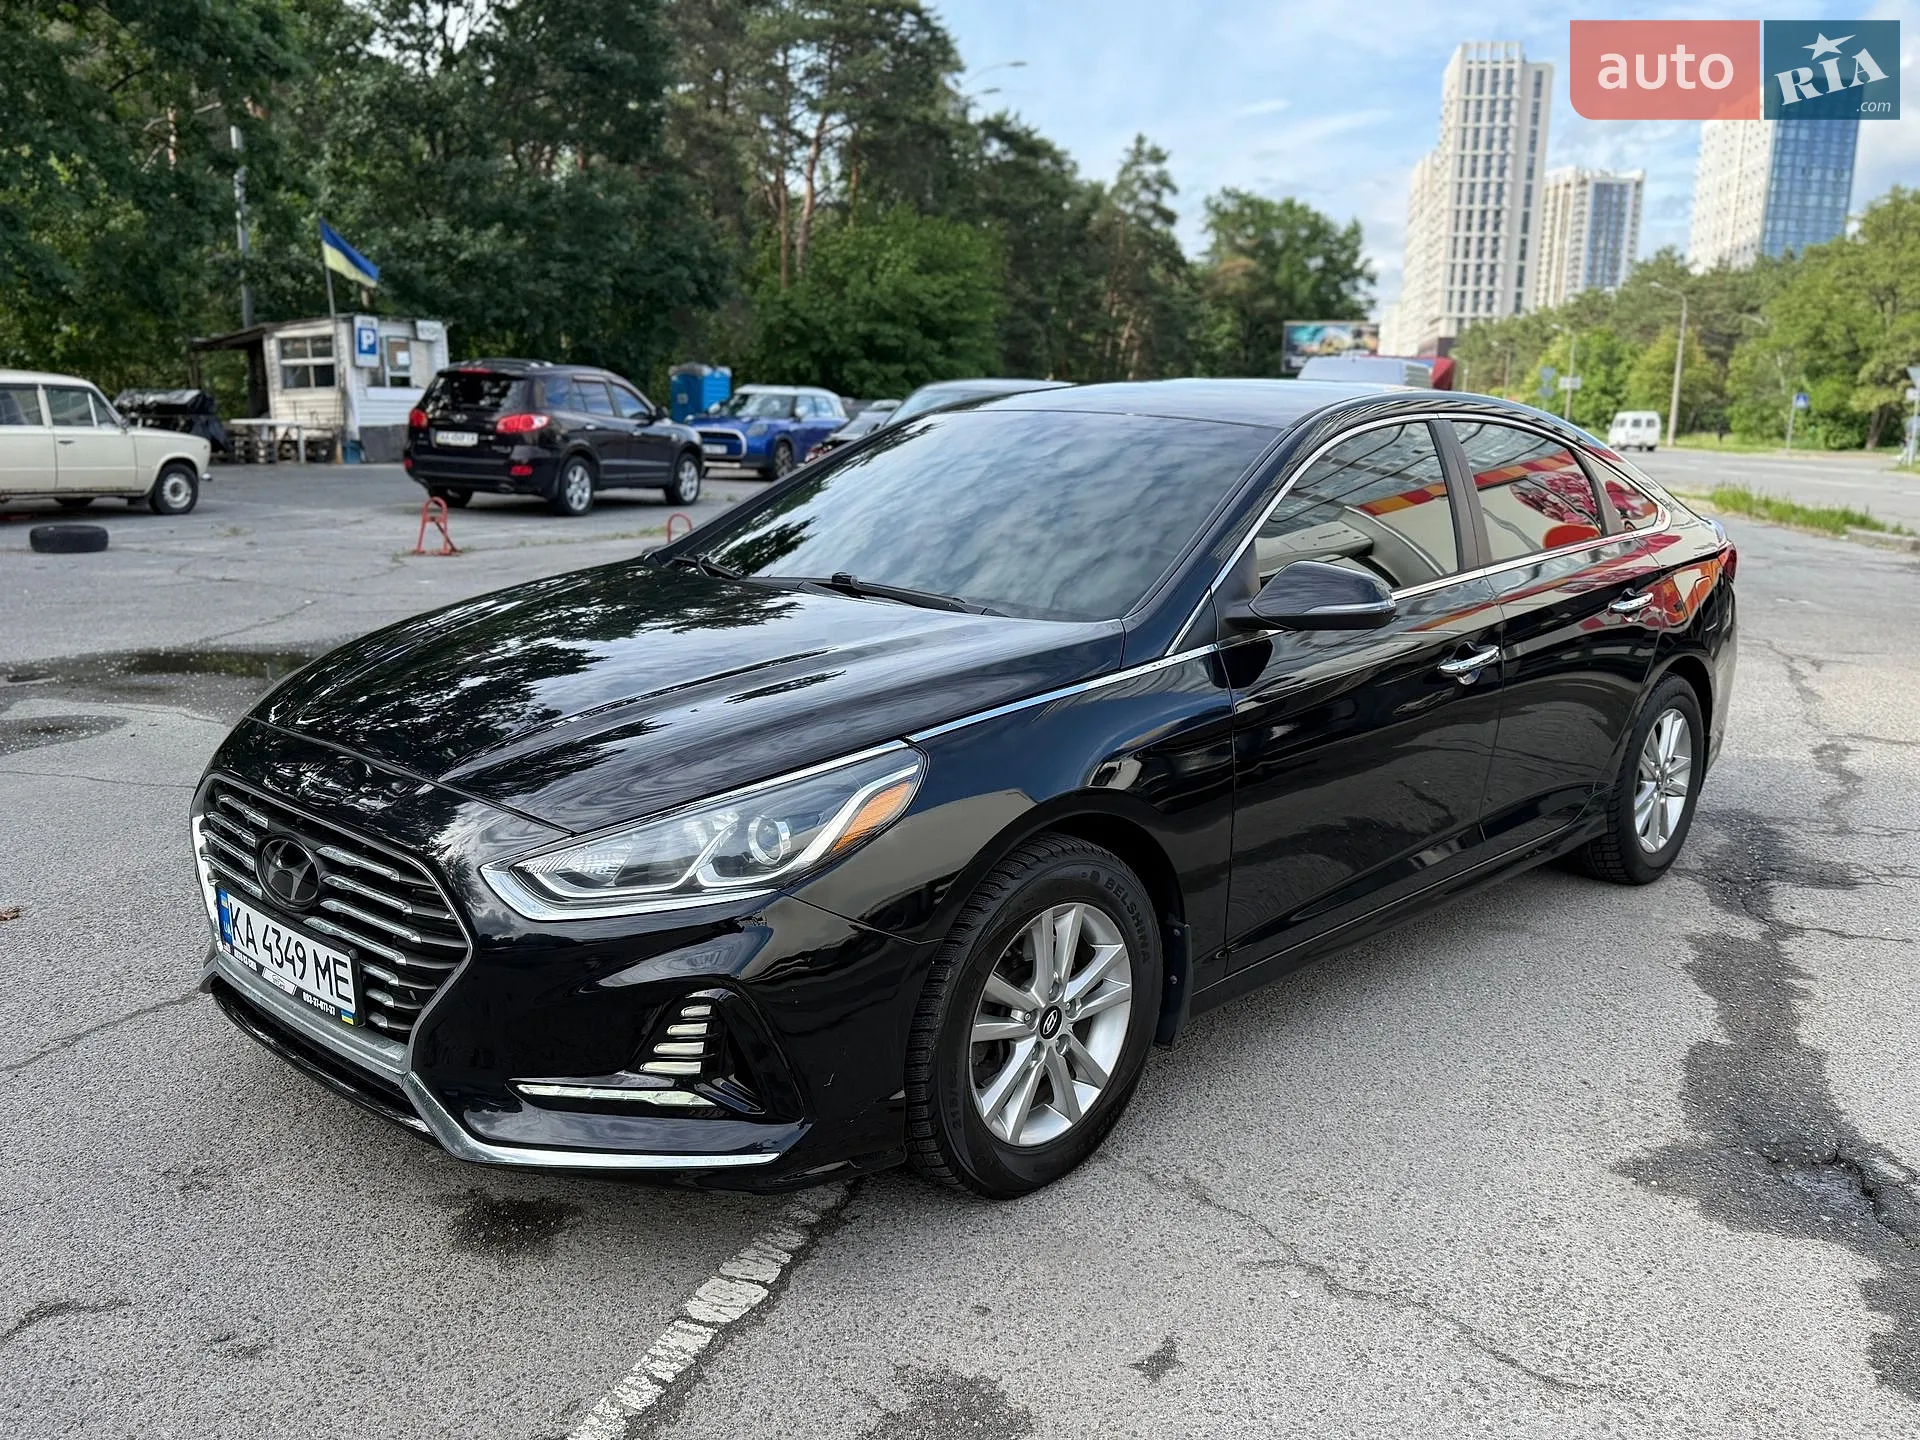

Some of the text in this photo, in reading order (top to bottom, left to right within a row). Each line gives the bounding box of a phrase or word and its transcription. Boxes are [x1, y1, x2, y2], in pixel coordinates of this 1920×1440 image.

[360, 329, 375, 351] P
[230, 902, 258, 956] KA
[262, 924, 307, 980] 4349
[313, 948, 352, 1005] ME
